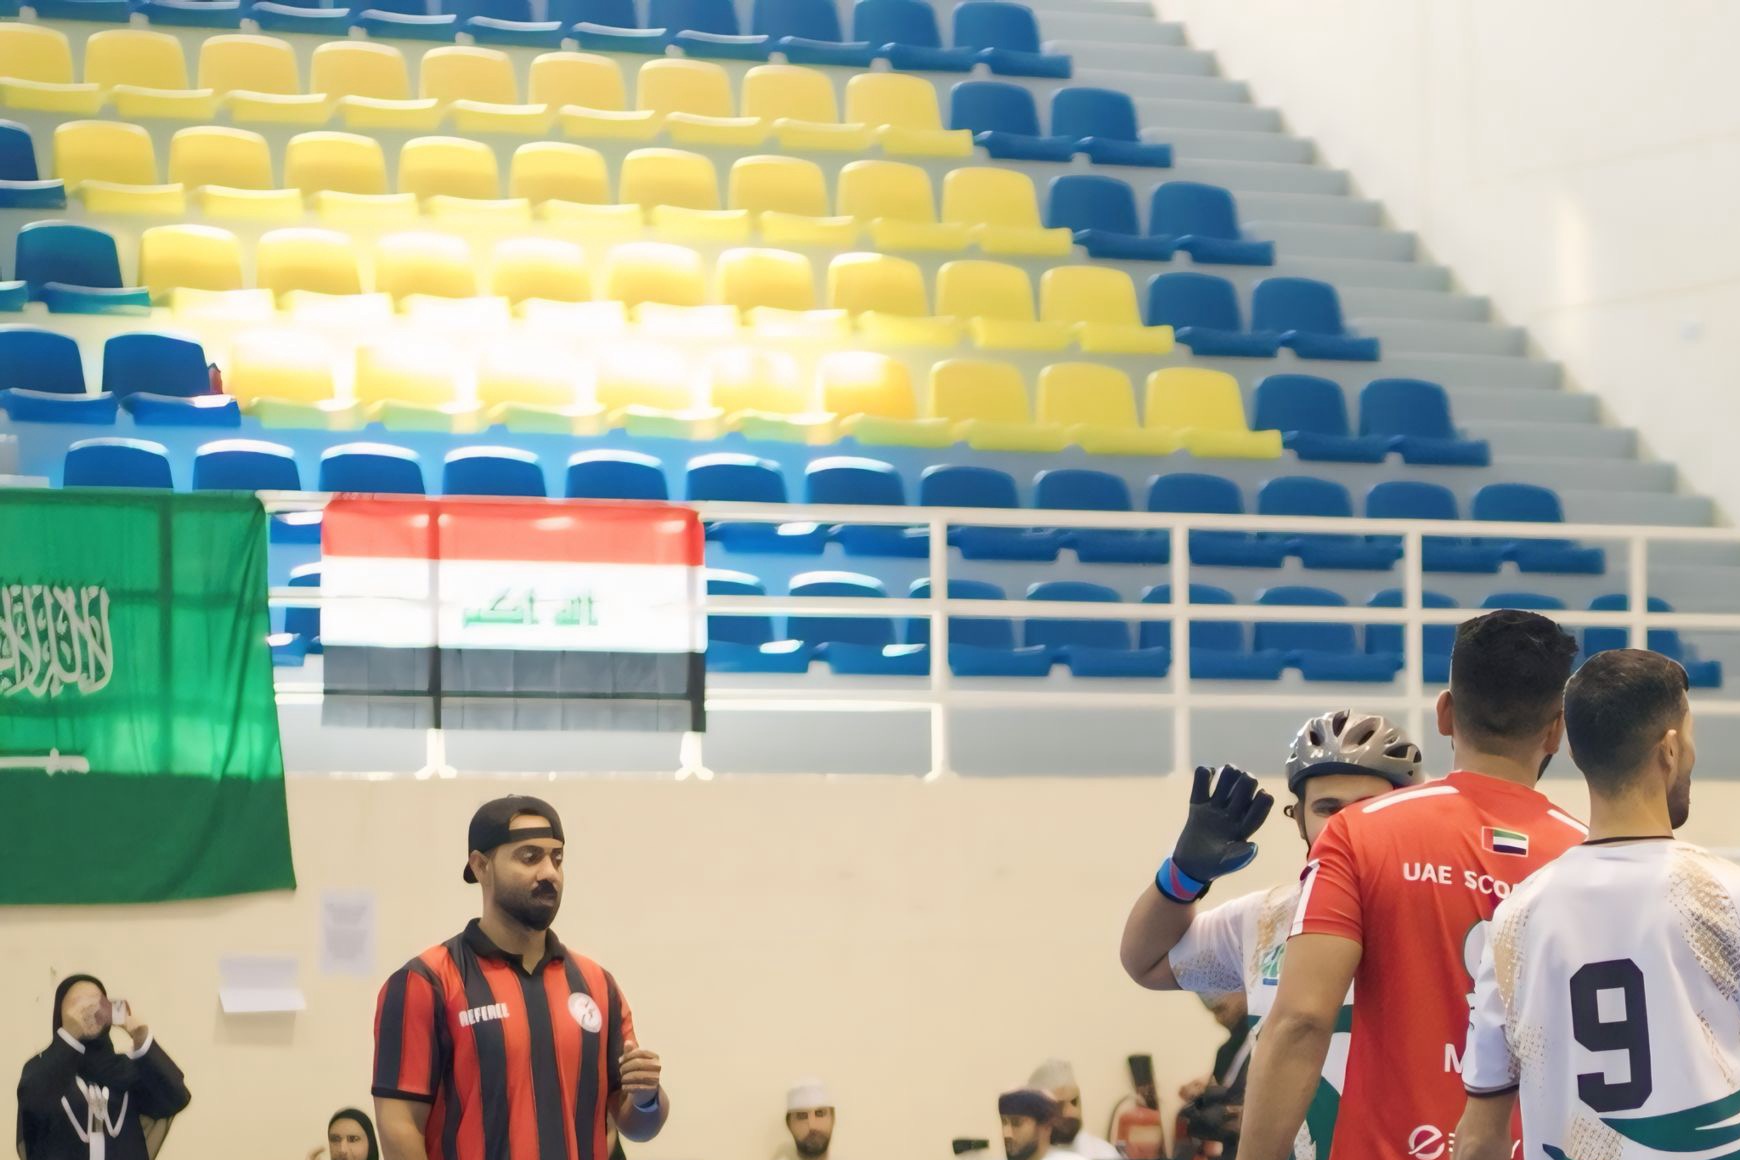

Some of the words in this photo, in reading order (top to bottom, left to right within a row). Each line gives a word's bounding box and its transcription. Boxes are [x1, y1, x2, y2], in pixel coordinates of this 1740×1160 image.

[1403, 862, 1452, 885] UAE
[1464, 870, 1516, 900] SCO
[1570, 958, 1653, 1113] 9
